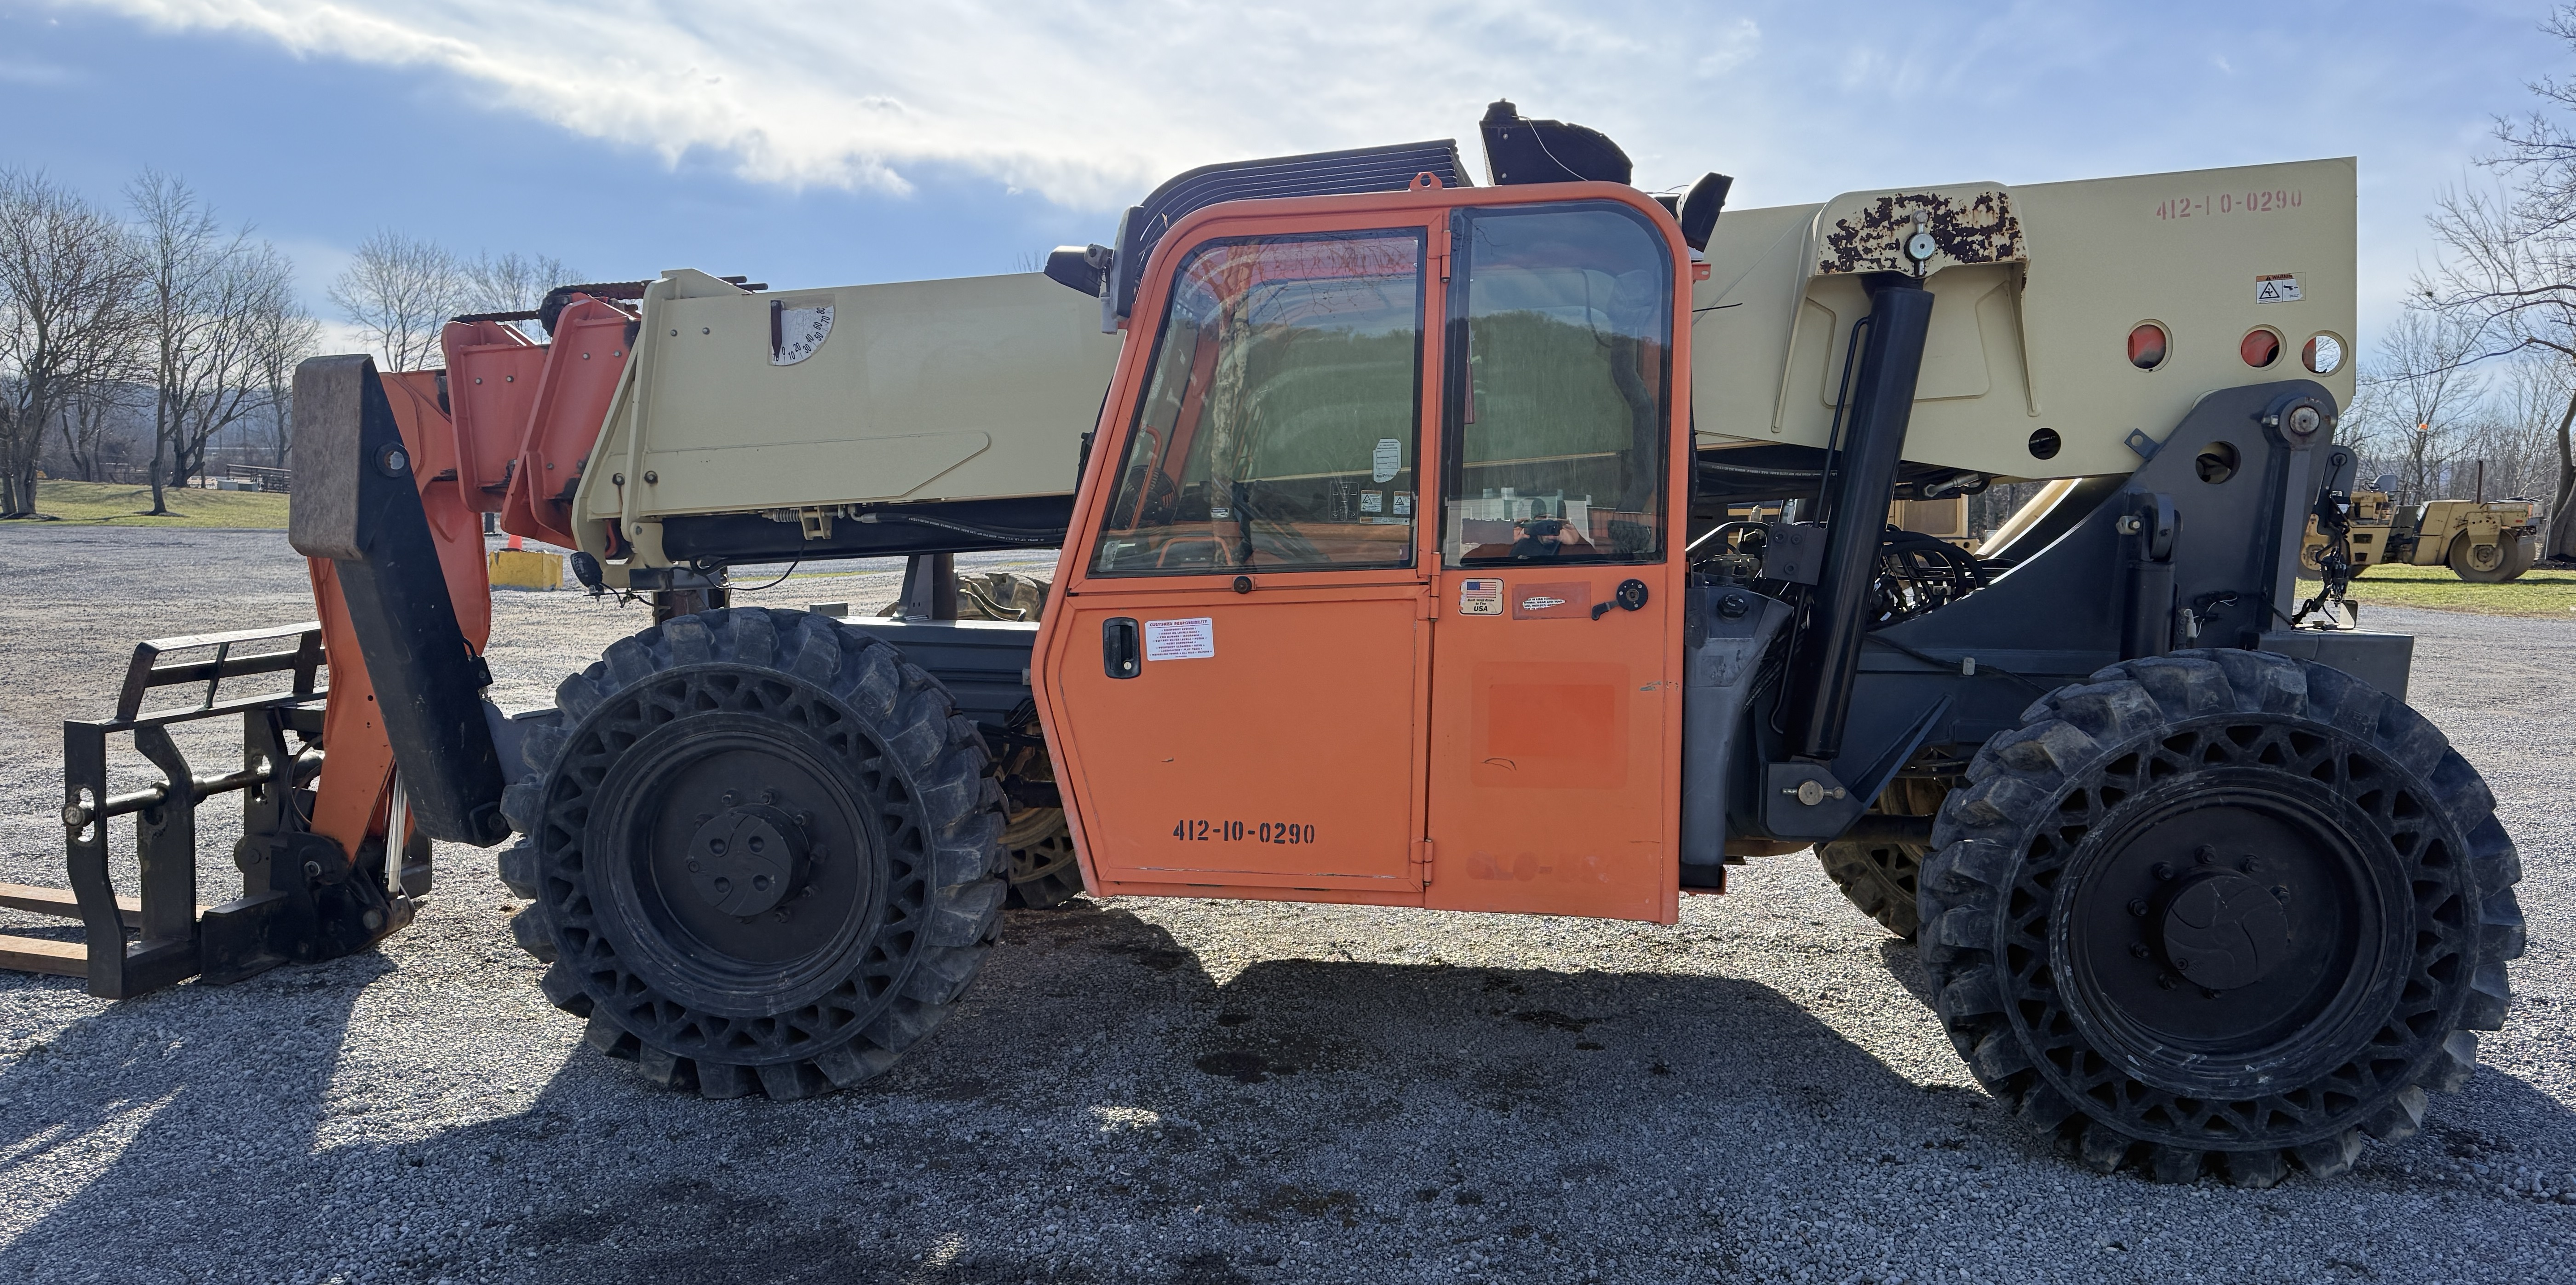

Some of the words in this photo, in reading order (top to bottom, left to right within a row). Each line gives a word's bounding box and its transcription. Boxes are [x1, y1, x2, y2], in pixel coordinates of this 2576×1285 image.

[821, 316, 830, 324] 70
[813, 322, 822, 330] 60
[805, 334, 814, 343] 40
[814, 332, 824, 341] 50
[782, 346, 786, 355] 0
[793, 342, 801, 352] 20
[803, 344, 812, 353] 30
[788, 351, 795, 360] 10
[1173, 820, 1315, 844] 412-10-0290
